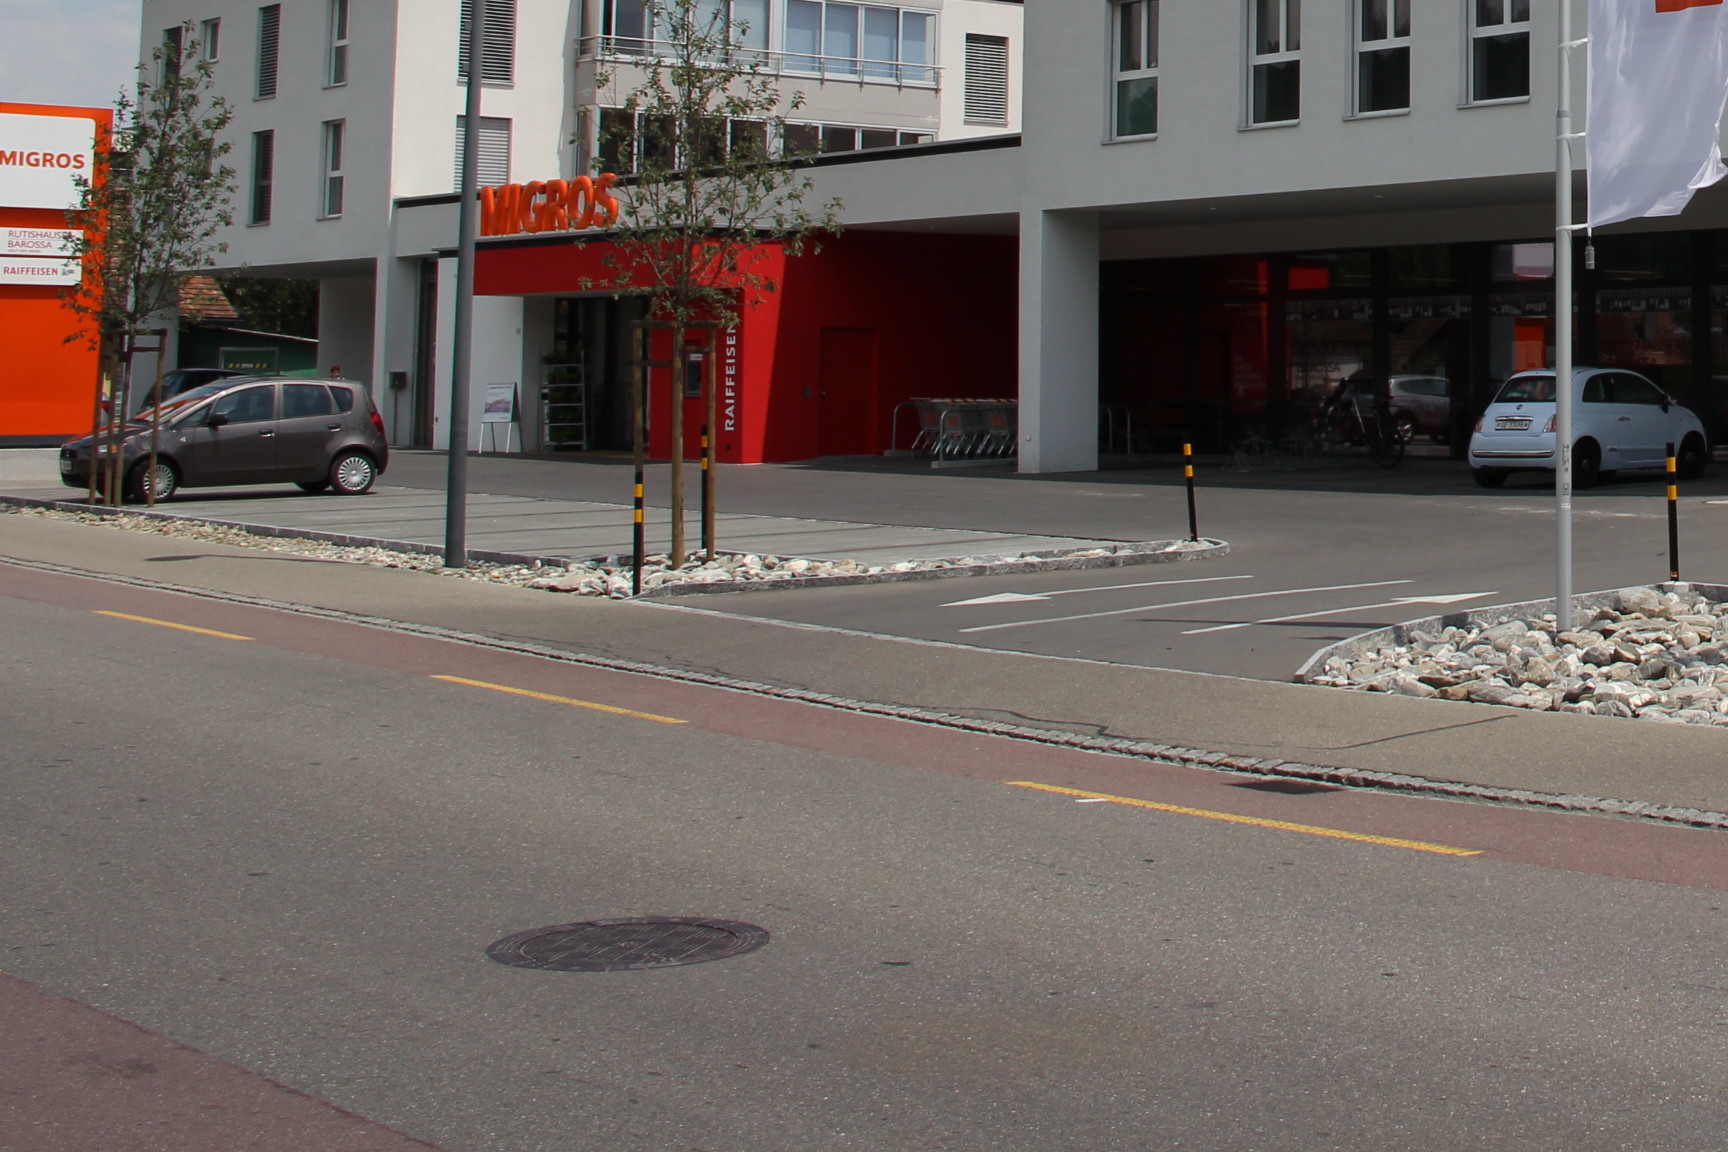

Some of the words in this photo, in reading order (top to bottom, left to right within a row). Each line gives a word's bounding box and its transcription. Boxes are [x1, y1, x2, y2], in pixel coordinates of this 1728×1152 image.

[0, 150, 86, 169] MIGROS
[480, 172, 619, 236] MIGROS
[8, 240, 53, 249] BAROSSA
[3, 266, 59, 276] RAIFFEISEN
[725, 324, 736, 431] RAIFFEISEN
